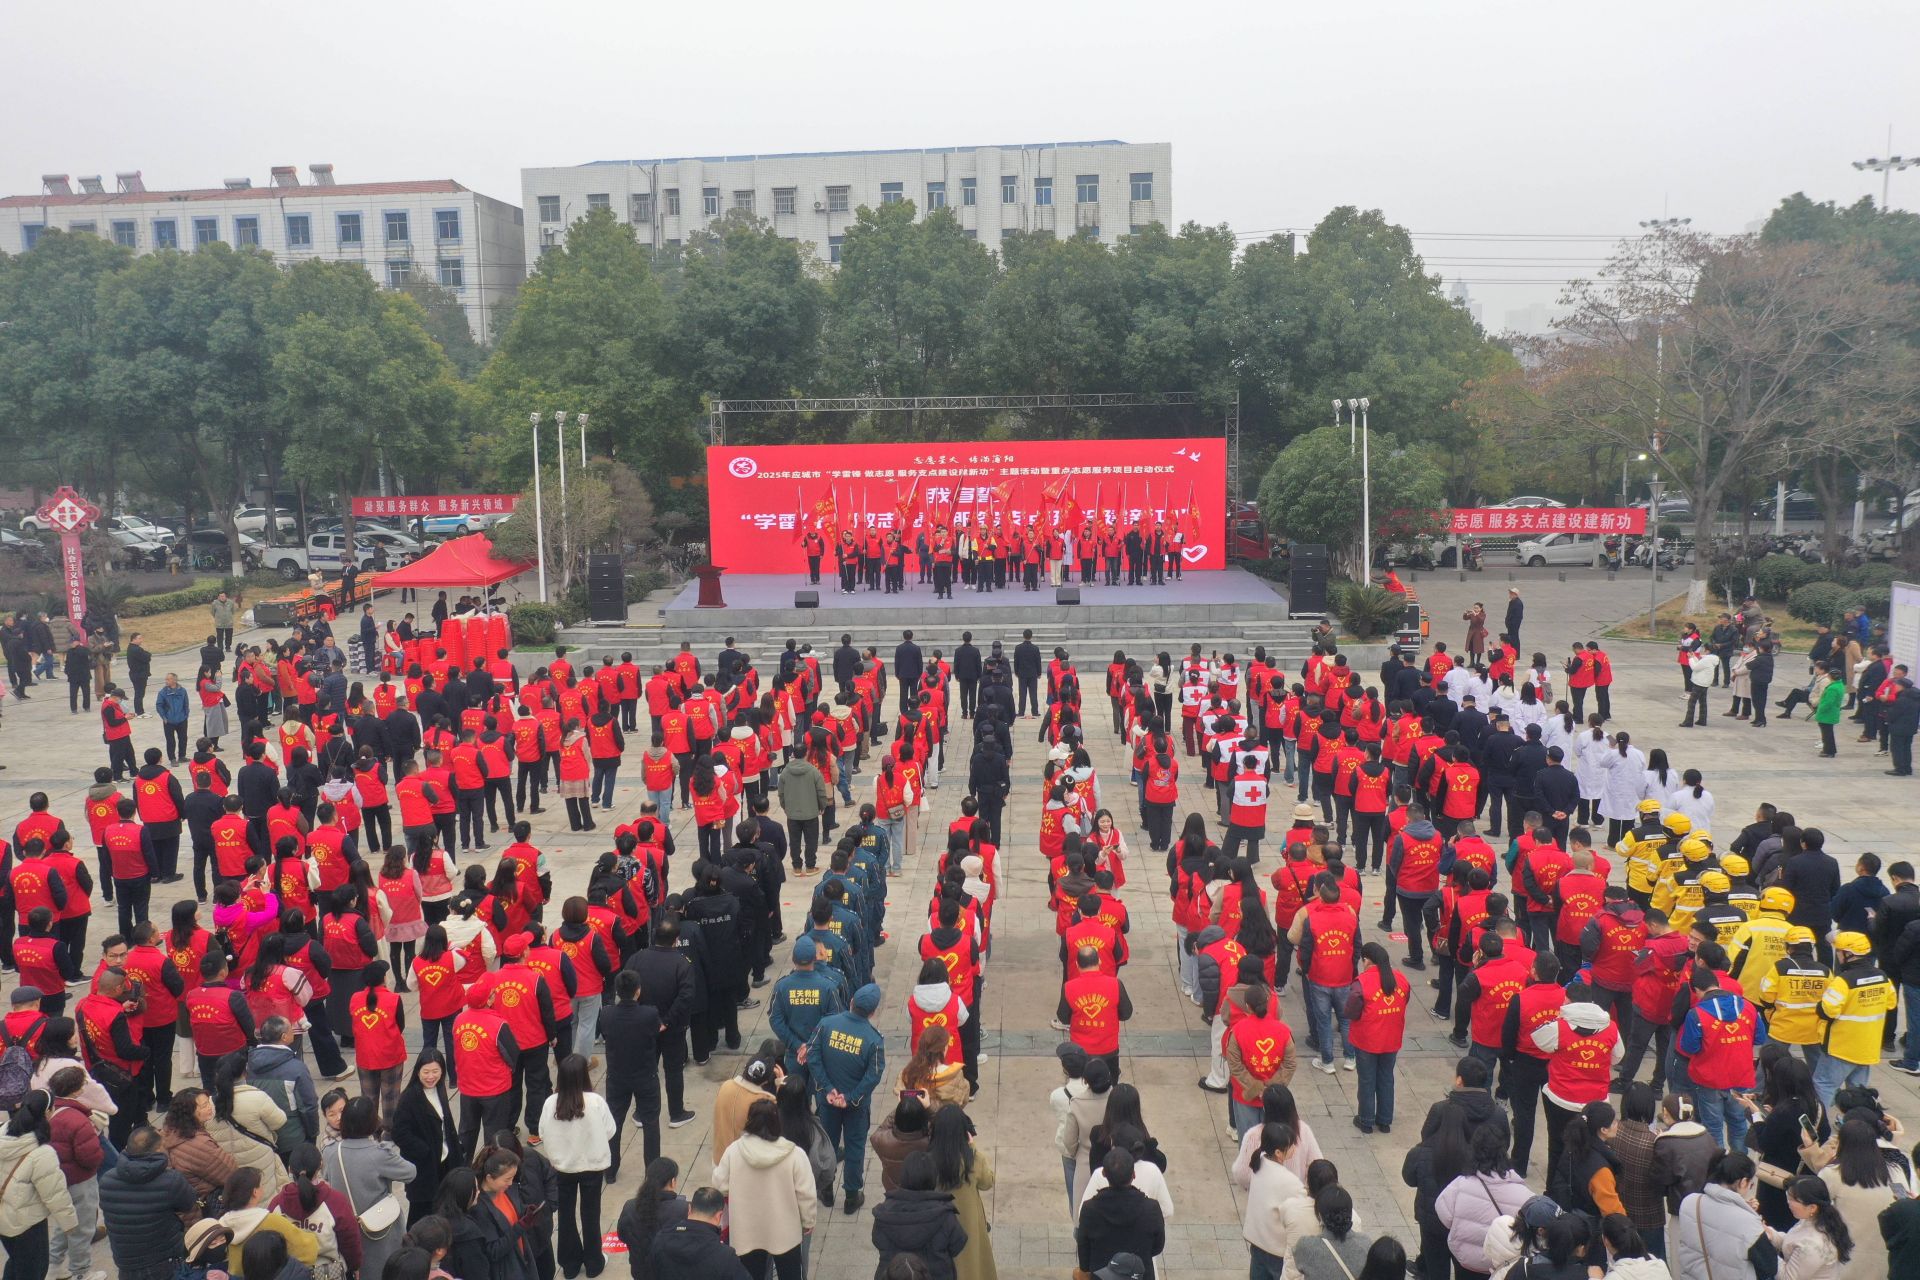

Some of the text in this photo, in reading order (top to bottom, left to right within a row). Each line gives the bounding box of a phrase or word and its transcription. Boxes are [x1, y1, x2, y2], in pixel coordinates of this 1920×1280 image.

[757, 470, 822, 479] 2025年应城市
[864, 469, 895, 477] 做志愿
[364, 499, 430, 513] 凝聚服务群众
[438, 497, 504, 512] 服务新兴领域
[1488, 512, 1632, 530] 服务支点建设建新功
[66, 546, 83, 620] 社会主义核心价值观
[1789, 979, 1824, 990] 订酒店
[789, 997, 820, 1005] RESCUE
[828, 1039, 861, 1055] RESCUE
